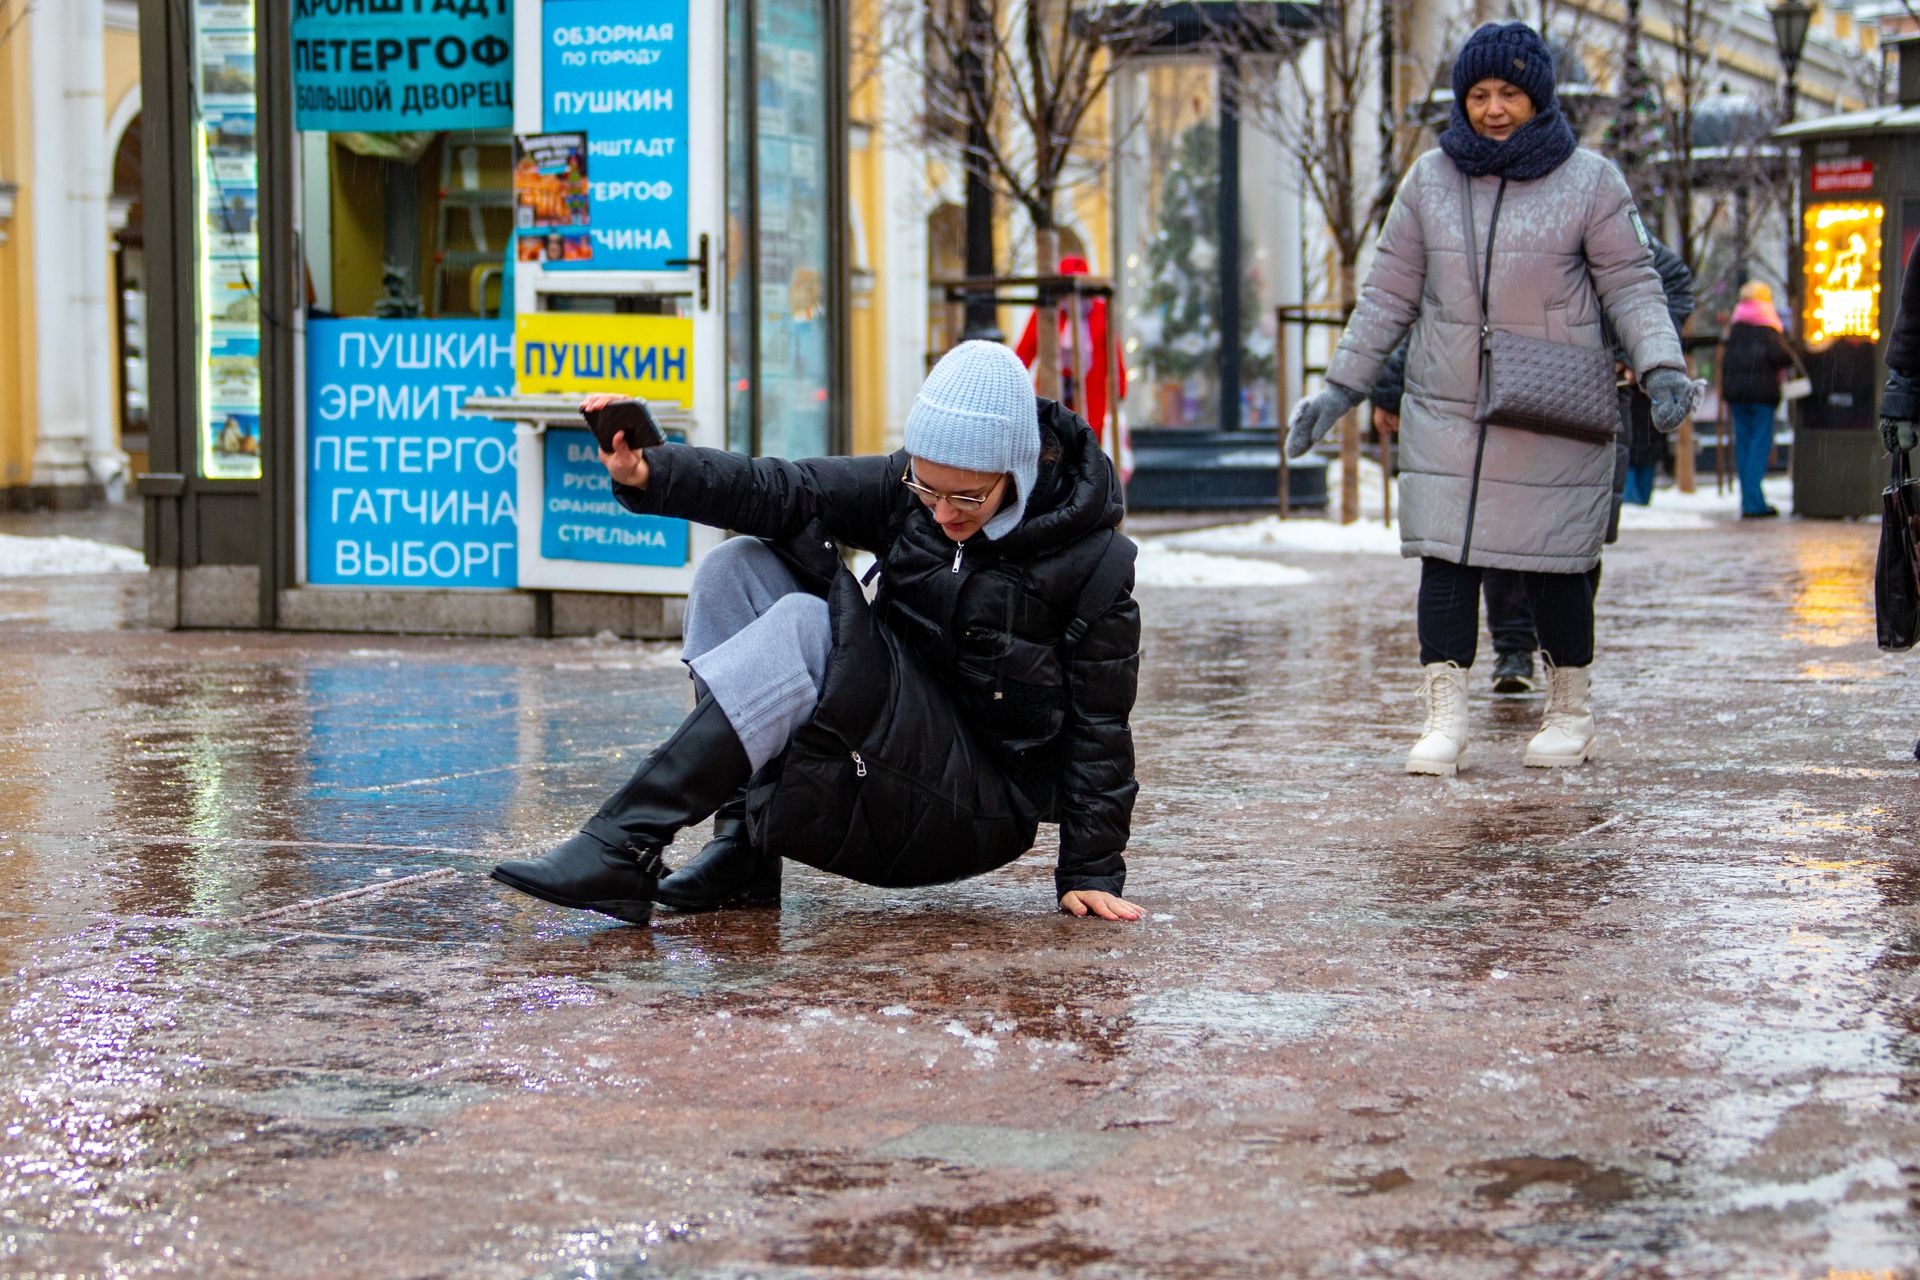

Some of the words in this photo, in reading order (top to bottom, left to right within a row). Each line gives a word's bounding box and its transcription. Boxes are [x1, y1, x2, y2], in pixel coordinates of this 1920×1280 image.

[553, 23, 674, 46] ОБЗОРНАЯ
[295, 34, 509, 72] ПЕТЕРГОФ
[562, 50, 587, 66] ПО
[591, 49, 661, 66] ГОРОДУ
[296, 80, 392, 112] БОЛЬШОЙ
[401, 81, 514, 116] ДВОРЕЦ
[553, 88, 673, 113] ПУШКИН
[588, 137, 675, 157] НШТАДТ
[589, 180, 673, 202] ЕРГОФ
[590, 228, 673, 250] ЧИНА
[338, 332, 515, 369] ПУШКИН
[524, 342, 686, 382] ПУШКИН
[319, 383, 515, 421] ЭРМИТ
[331, 488, 518, 526] ГАТЧИНА
[558, 524, 667, 547] СТРЕЛЬНА
[335, 539, 514, 578] ВЫБОРГ
